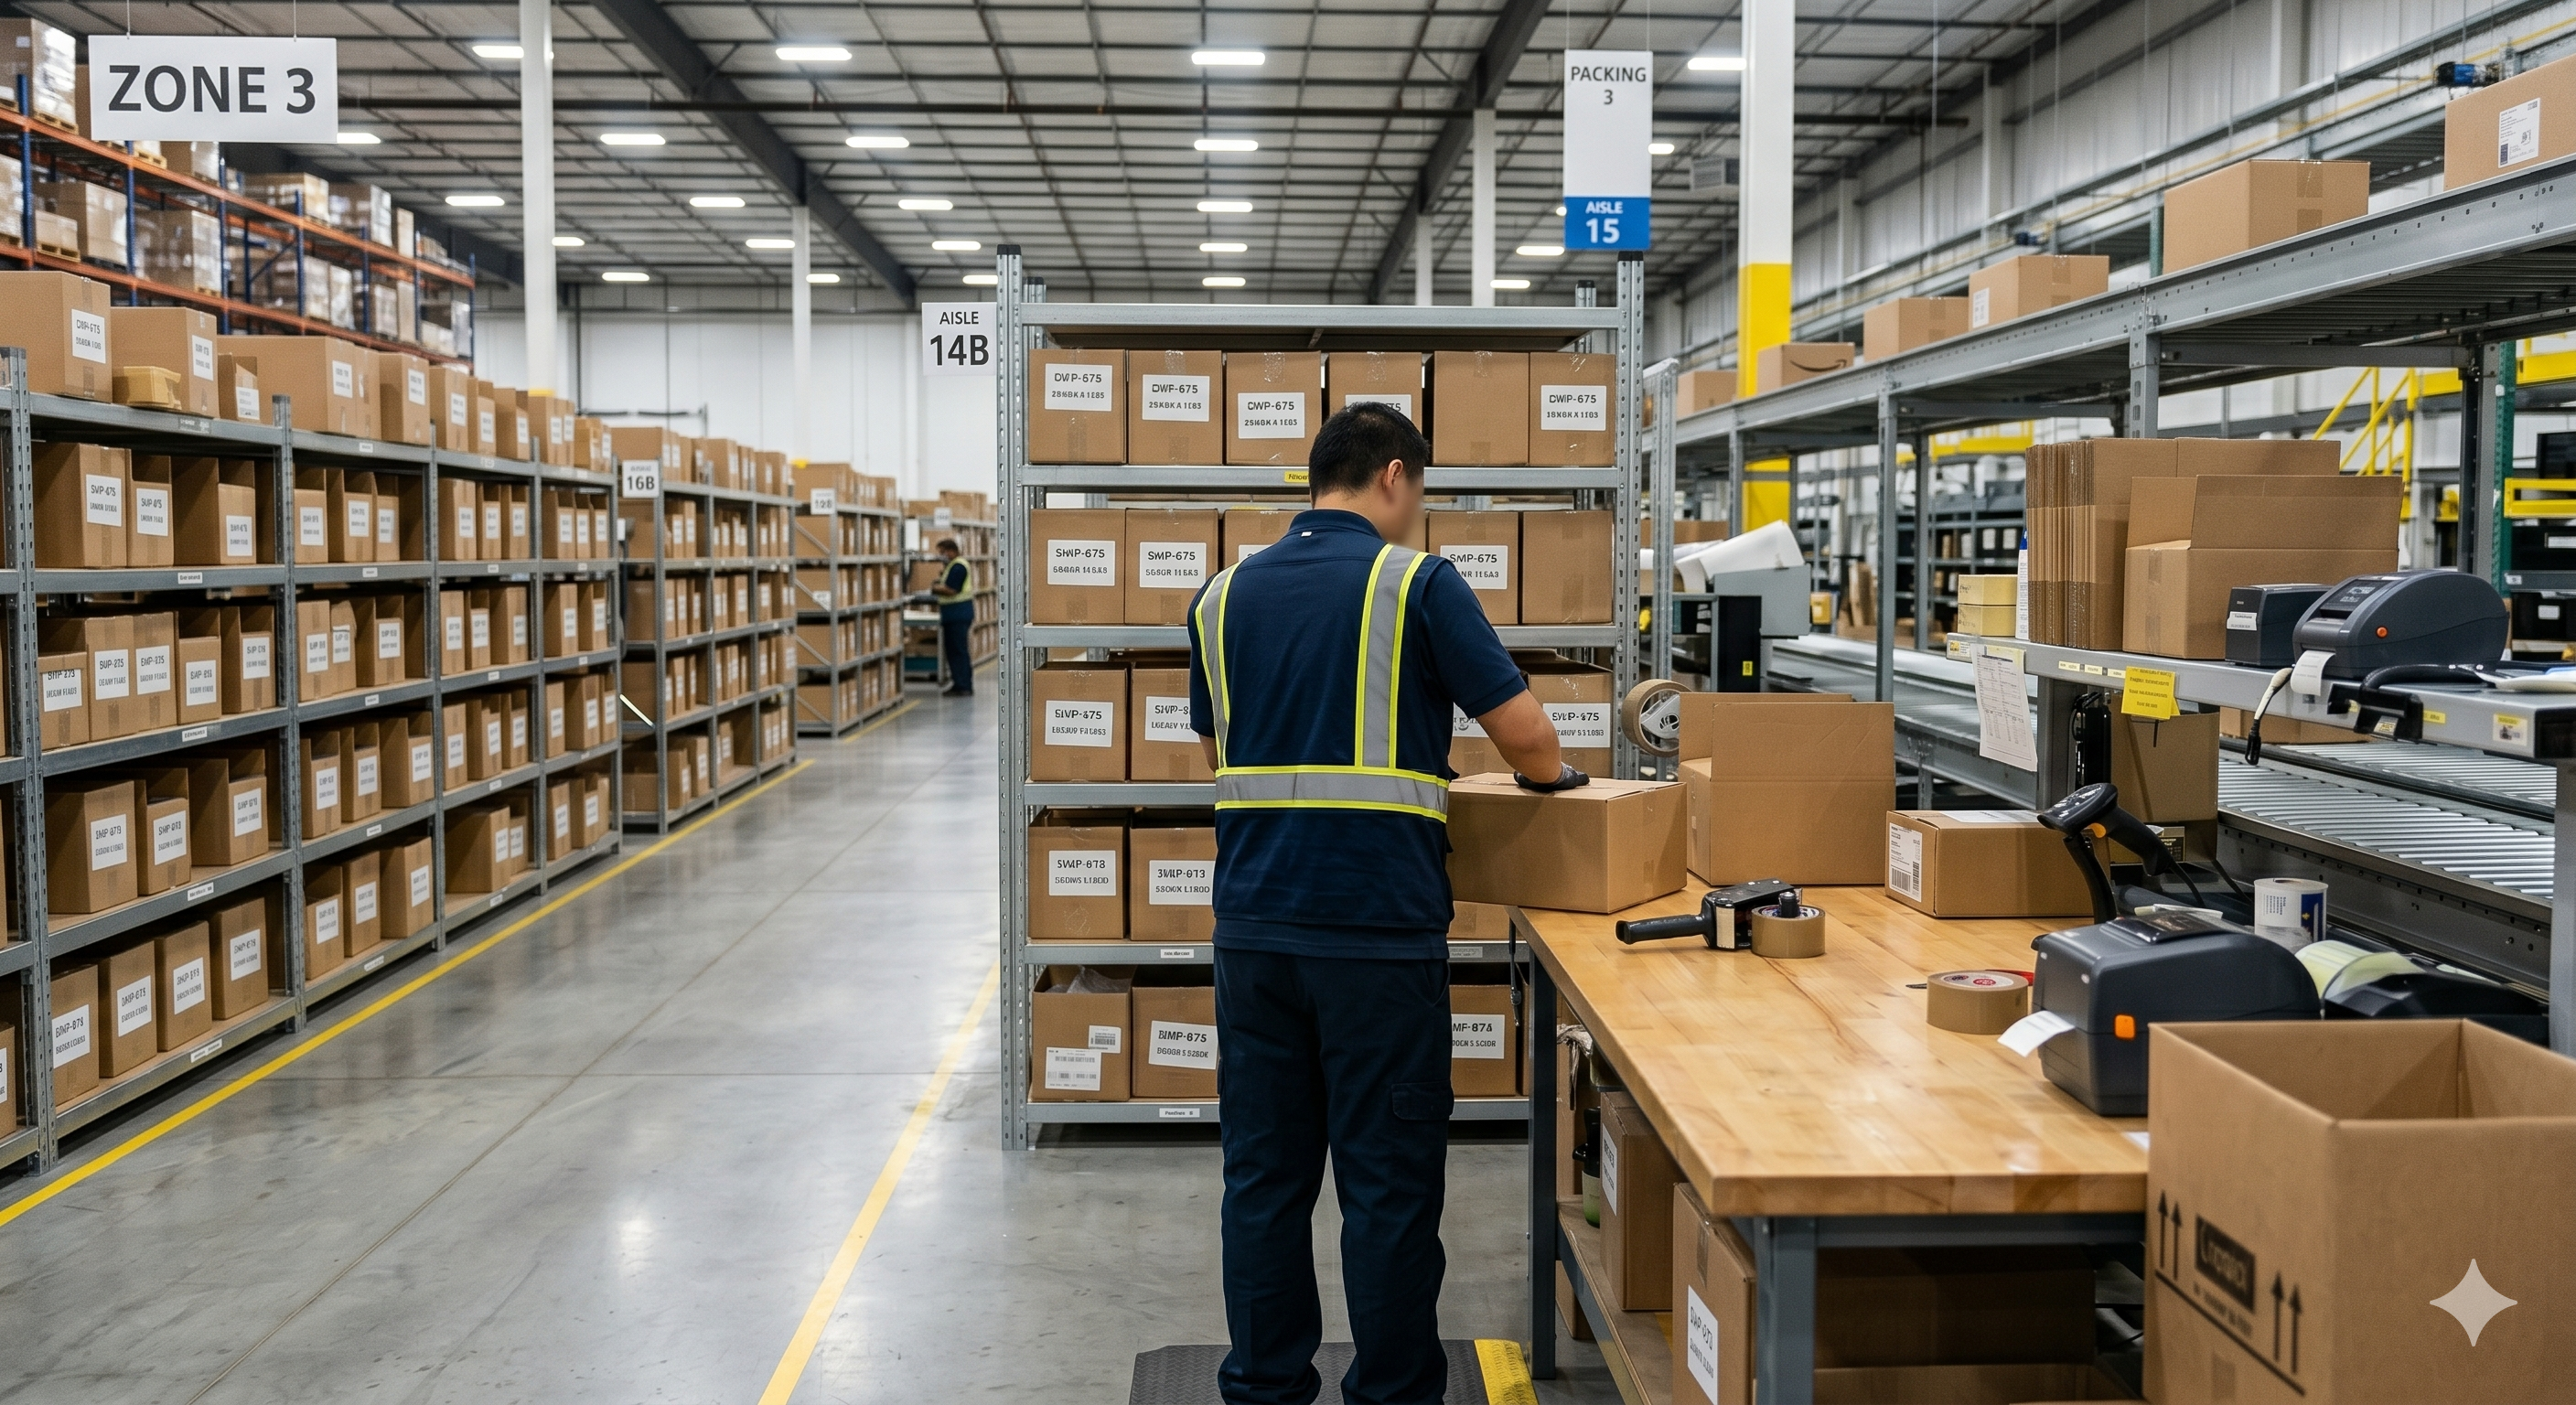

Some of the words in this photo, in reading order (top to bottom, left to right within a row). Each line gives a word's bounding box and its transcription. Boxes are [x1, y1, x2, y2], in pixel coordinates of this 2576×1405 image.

[1570, 66, 1647, 83] PACKING
[109, 65, 268, 113] ZONE
[286, 67, 317, 114] 3
[1603, 89, 1614, 105] 3
[1585, 201, 1624, 215] AISLE
[1586, 218, 1621, 244] 15
[939, 311, 979, 326] AISLE
[929, 334, 990, 366] 14B
[627, 475, 655, 491] 16B
